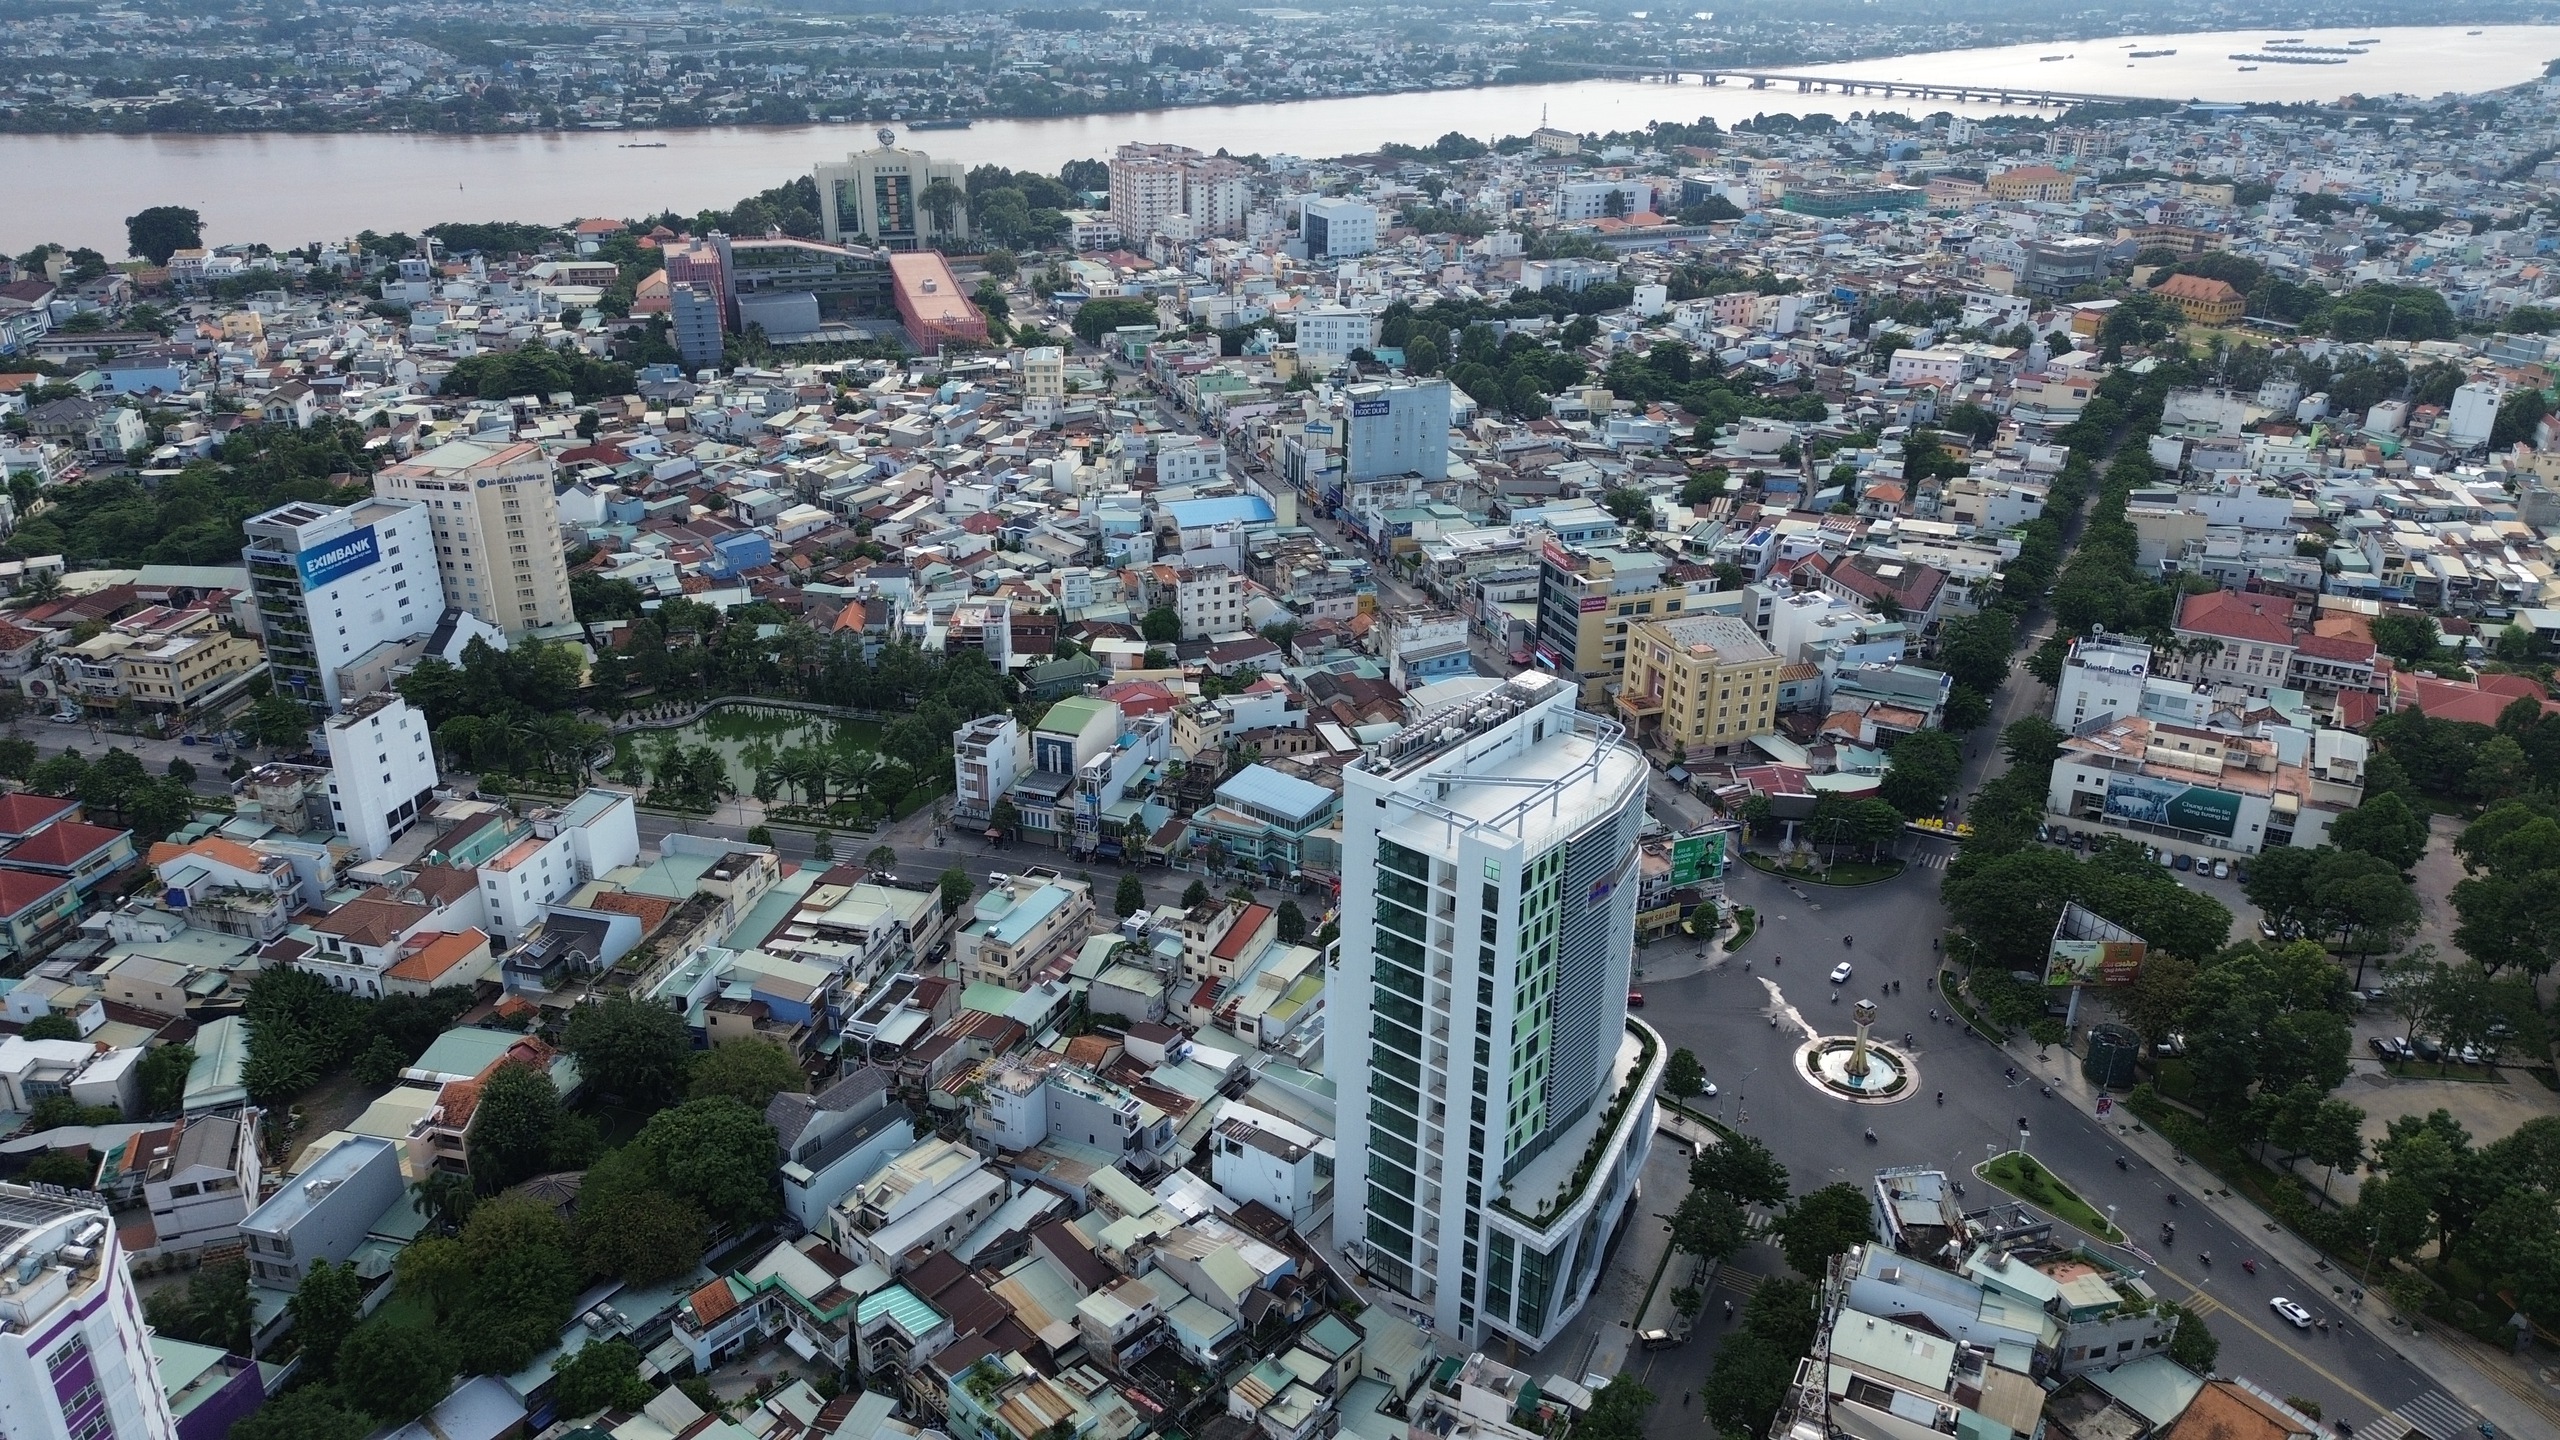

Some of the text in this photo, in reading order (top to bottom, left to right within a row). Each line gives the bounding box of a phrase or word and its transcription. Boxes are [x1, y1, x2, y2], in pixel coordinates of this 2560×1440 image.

[306, 537, 371, 573] EXIMBANK
[2182, 801, 2203, 811] Chung
[2204, 805, 2220, 814] niềm
